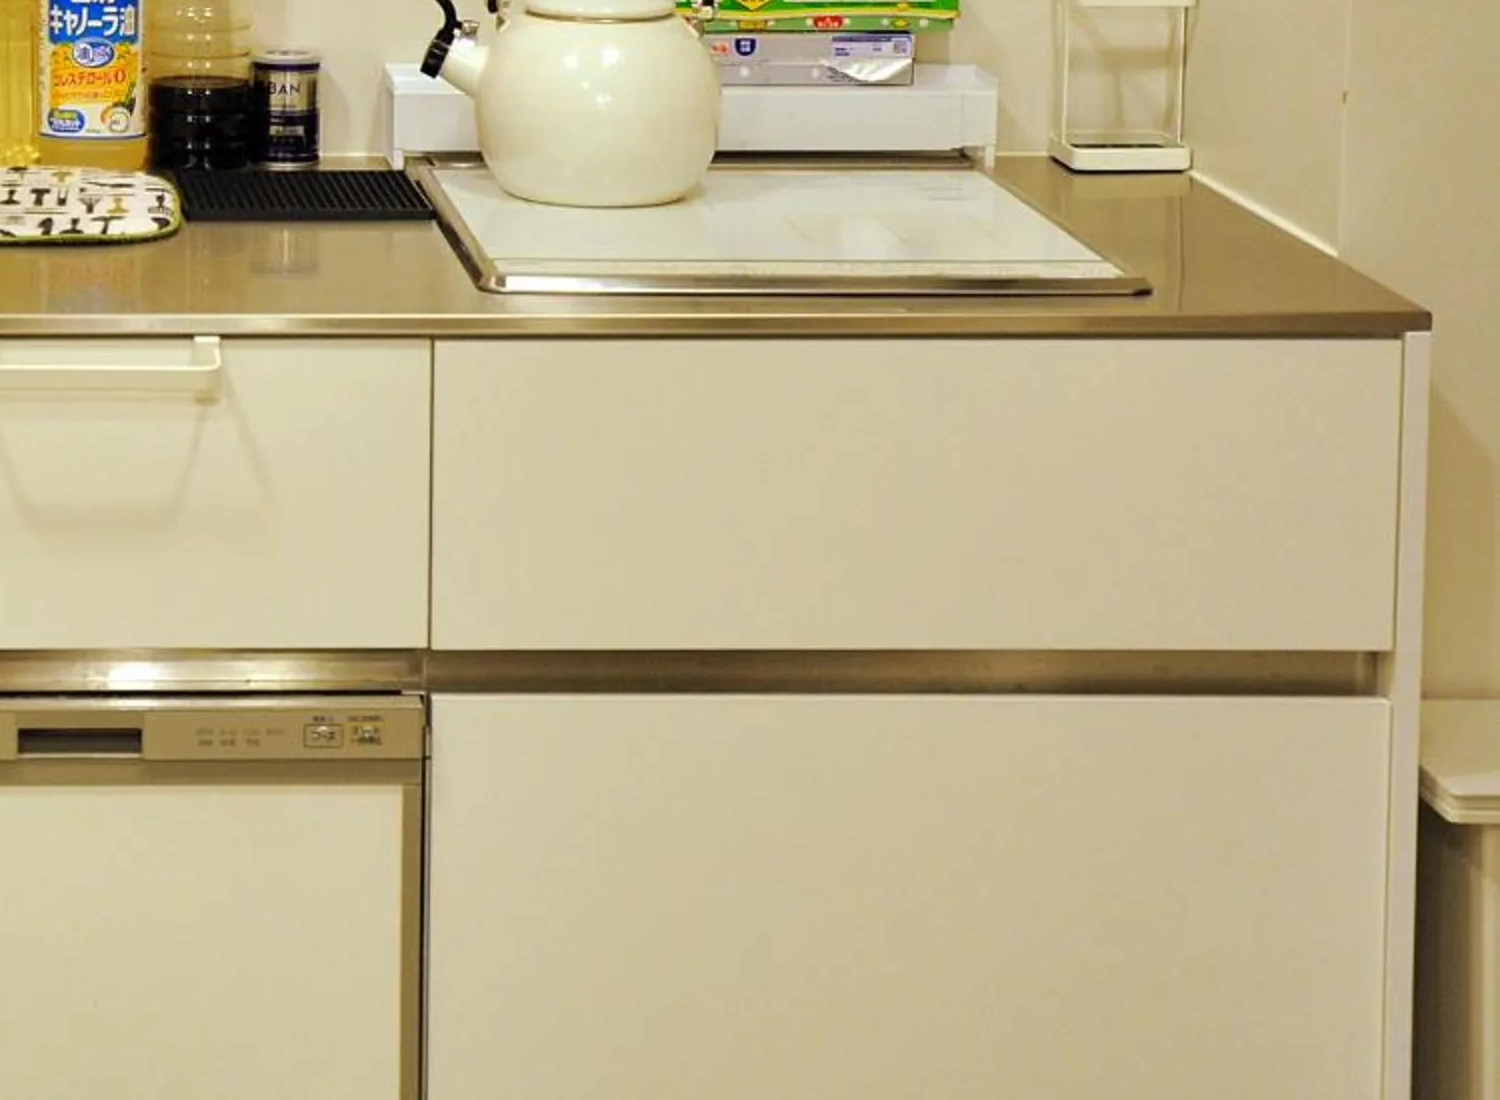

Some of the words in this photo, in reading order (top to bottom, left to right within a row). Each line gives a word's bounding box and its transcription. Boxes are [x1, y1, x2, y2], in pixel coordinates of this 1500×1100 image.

[49, 4, 135, 37] キャノーラ油
